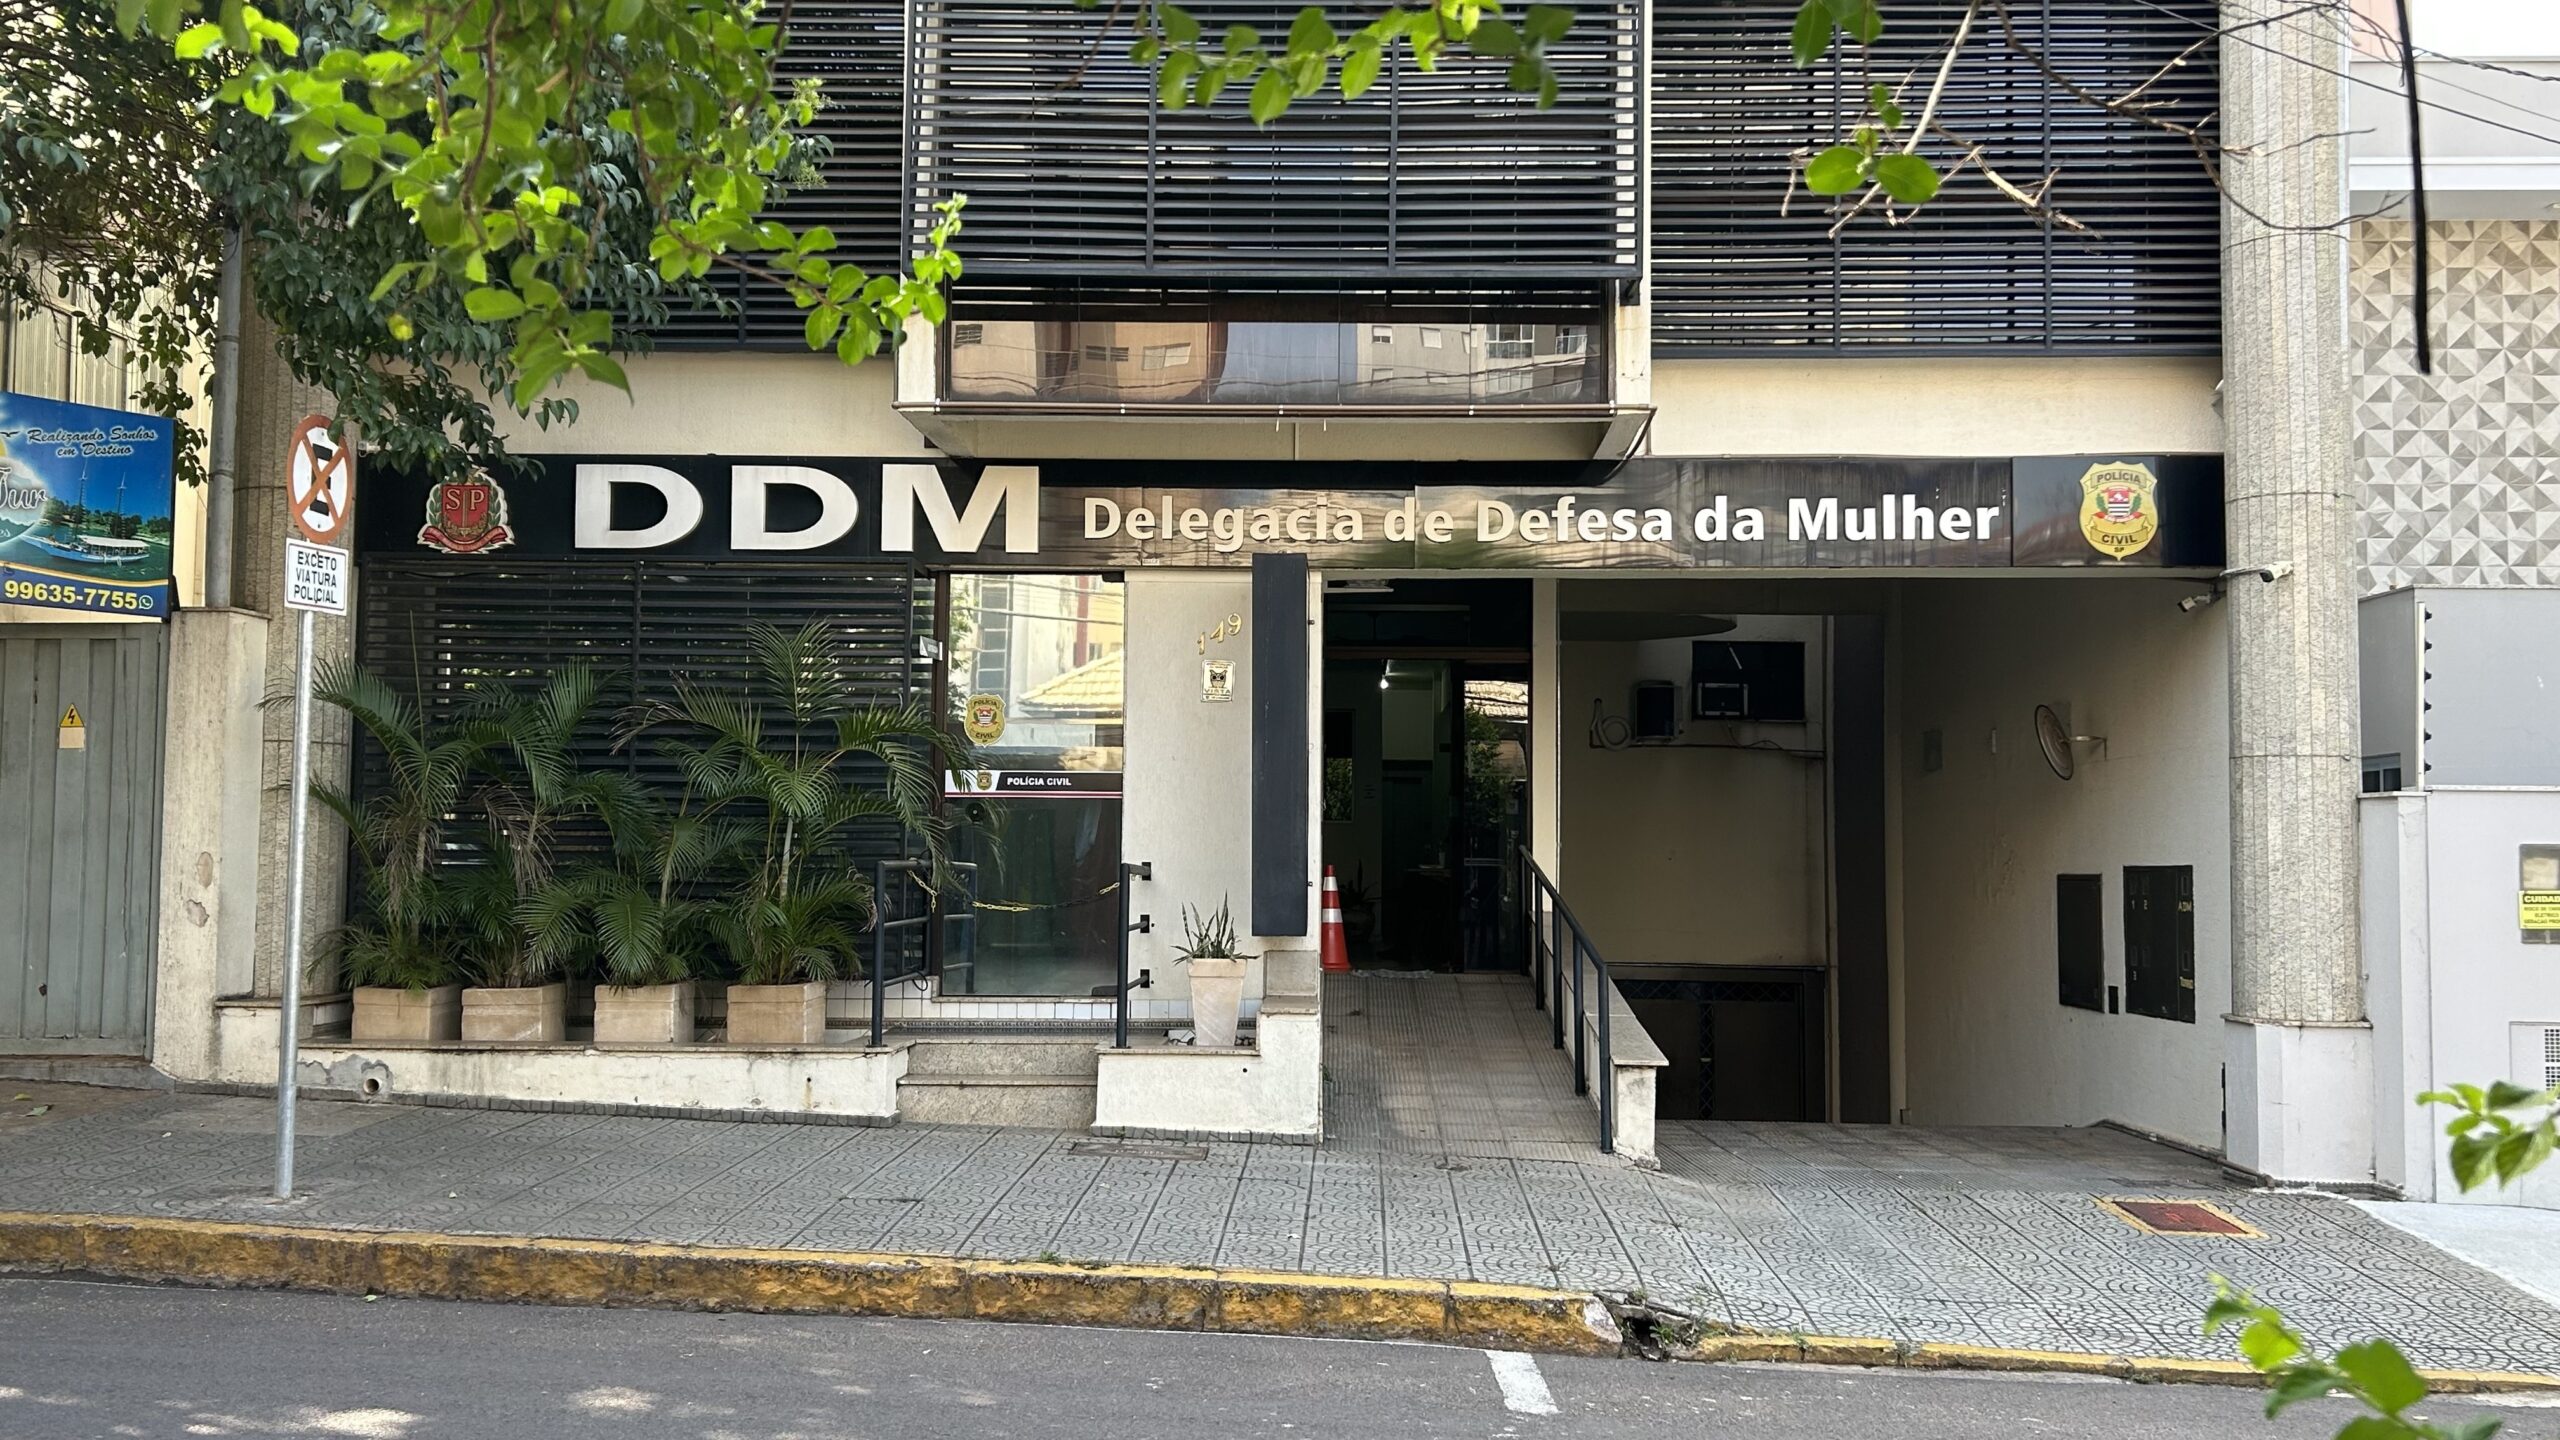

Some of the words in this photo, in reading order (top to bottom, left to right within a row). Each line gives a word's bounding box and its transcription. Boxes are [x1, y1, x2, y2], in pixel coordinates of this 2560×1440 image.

[27, 428, 105, 446] Realizando
[109, 426, 157, 442] Sonhos
[57, 446, 76, 456] em
[81, 442, 133, 456] Destino
[2096, 471, 2142, 484] POLÍCIA
[574, 463, 1040, 554] DDM
[1083, 495, 1365, 553] Delegacia
[1383, 497, 1454, 543] de
[1476, 495, 1674, 543] Defesa
[1694, 495, 1765, 541] da
[1787, 494, 2000, 541] Mulher
[2102, 534, 2138, 545] CIVIL
[297, 550, 337, 571] EXCETO
[295, 567, 337, 588] VIATURA
[4, 580, 138, 610] 99635-7755
[293, 584, 338, 604] POLICIAL
[1197, 613, 1242, 656] 149
[1006, 776, 1044, 786] POLÍCIA
[1047, 778, 1072, 786] CIVIL
